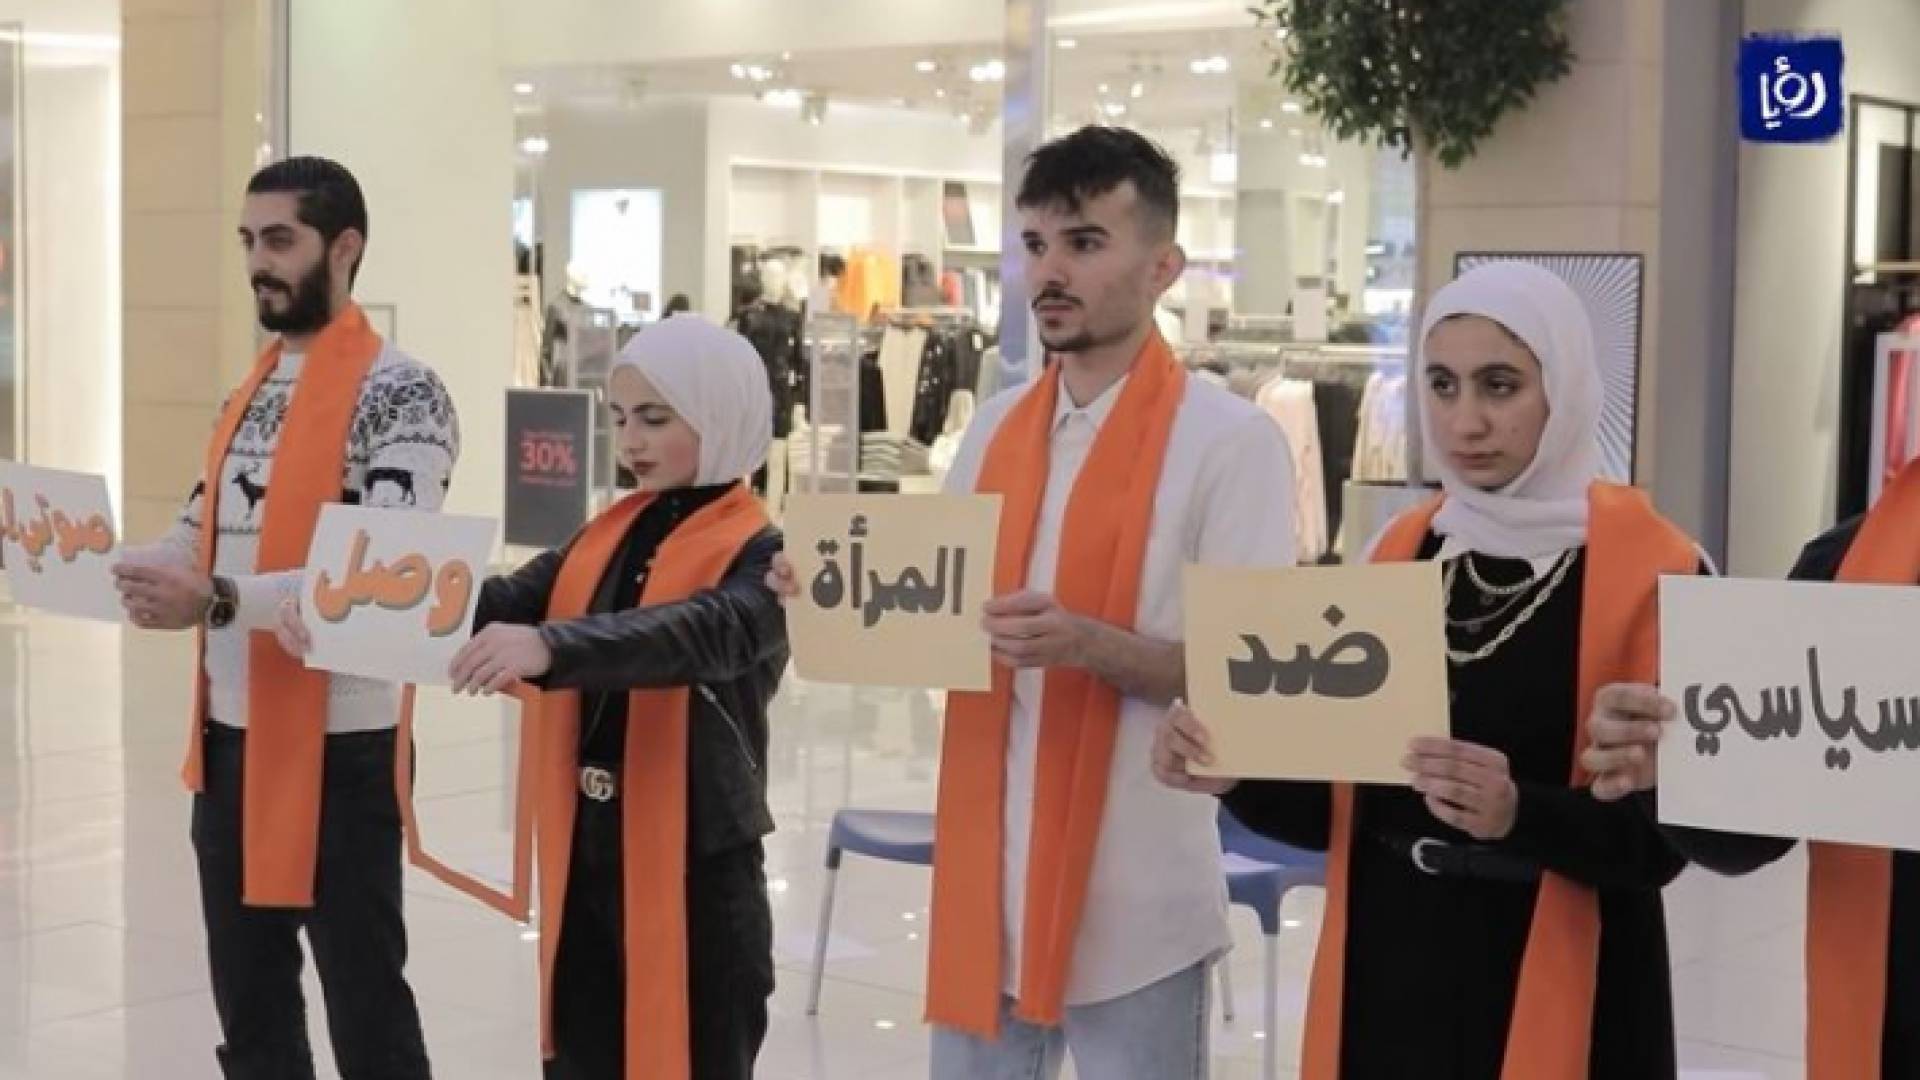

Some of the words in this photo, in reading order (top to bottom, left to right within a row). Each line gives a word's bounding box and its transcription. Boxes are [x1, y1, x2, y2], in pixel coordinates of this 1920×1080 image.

[520, 441, 578, 474] 30%
[314, 528, 473, 637] وصل
[811, 514, 967, 628] المرأة
[1226, 604, 1389, 698] ضد
